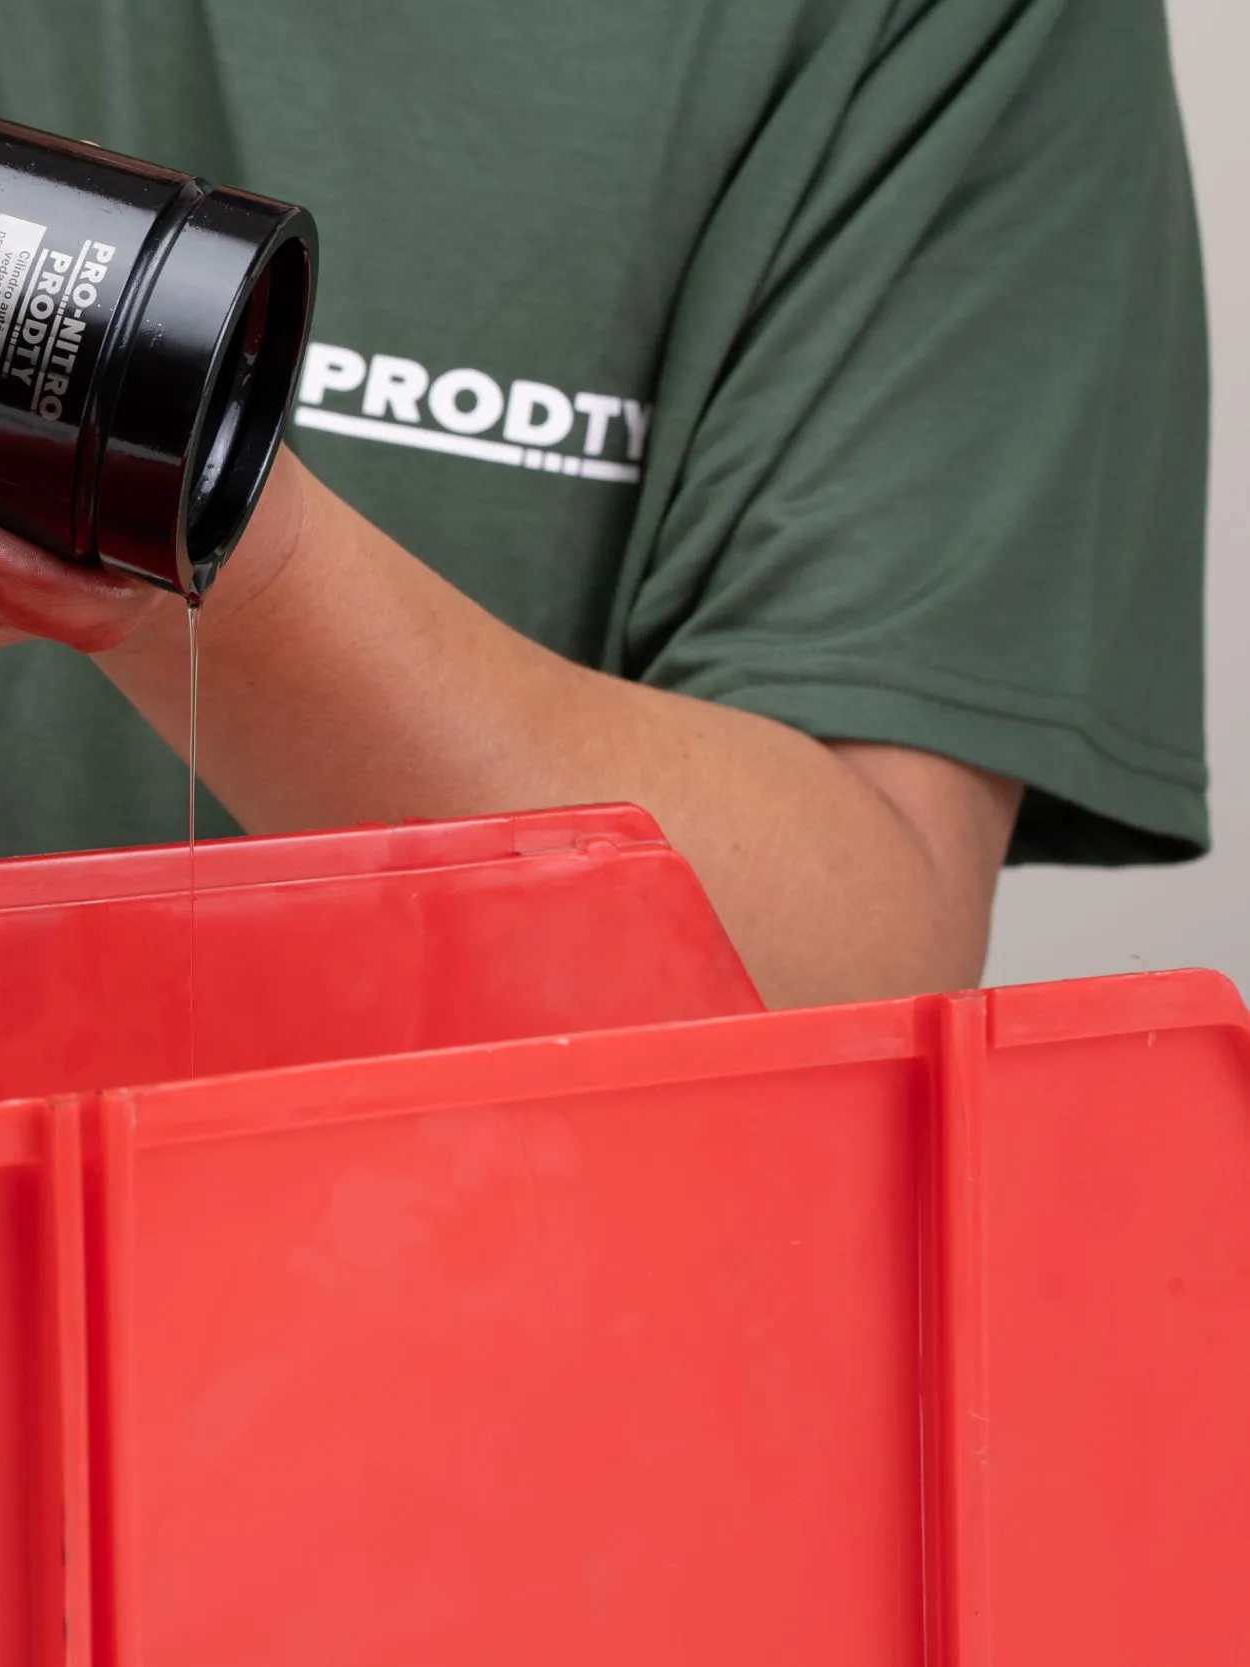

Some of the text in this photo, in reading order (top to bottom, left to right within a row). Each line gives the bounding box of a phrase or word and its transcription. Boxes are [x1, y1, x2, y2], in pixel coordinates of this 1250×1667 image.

[3, 250, 31, 300] Cilindro
[10, 250, 74, 386] PRODTY
[34, 241, 117, 424] PRO-NITRO
[299, 342, 650, 460] PRODTY
